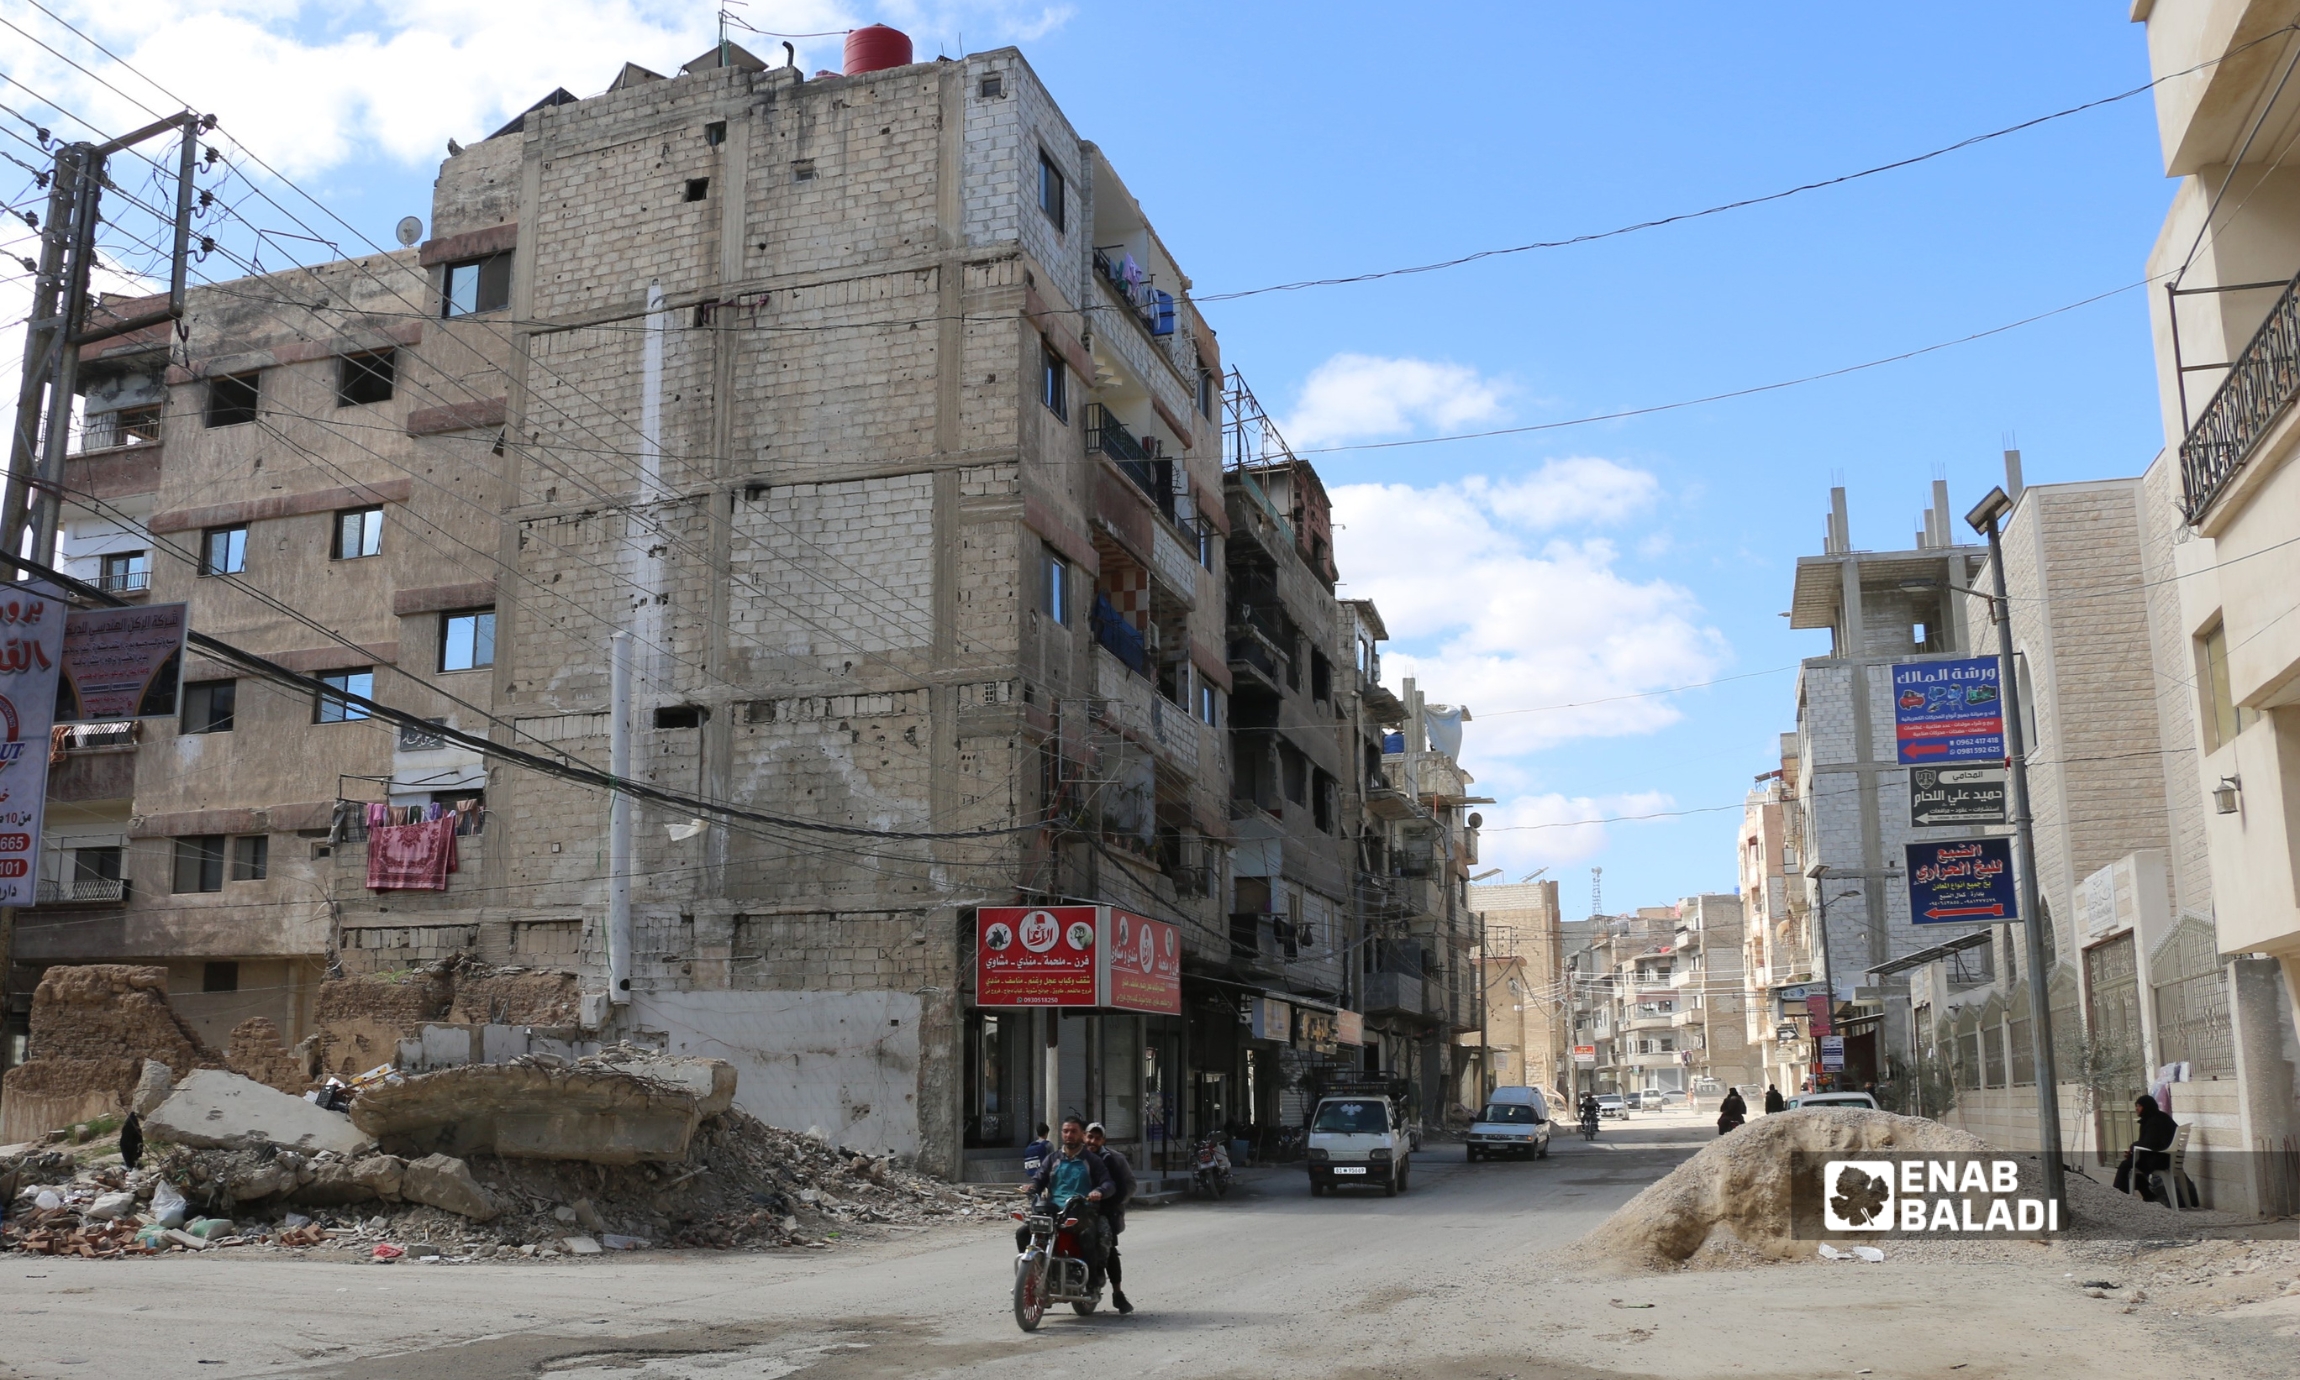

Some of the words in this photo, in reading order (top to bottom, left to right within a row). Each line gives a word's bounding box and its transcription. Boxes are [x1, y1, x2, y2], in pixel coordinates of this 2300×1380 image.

[0, 601, 44, 626] برو
[0, 638, 52, 672] الق
[1896, 668, 1948, 684] المالك
[1951, 666, 1996, 681] ورشة
[0, 743, 25, 760] UT
[1952, 771, 1983, 782] المحامي
[1913, 790, 1945, 808] اللحام
[1947, 789, 1970, 806] علي
[1973, 790, 2003, 802] حميد
[6, 812, 17, 823] 10
[18, 811, 31, 827] من
[0, 836, 24, 850] 665
[0, 861, 20, 875] 101
[1916, 861, 1971, 884] الحراري
[985, 954, 1009, 970] مشاوي
[1016, 955, 1037, 969] مندي
[1043, 955, 1066, 967] ملحمة
[1074, 955, 1090, 968] فرن
